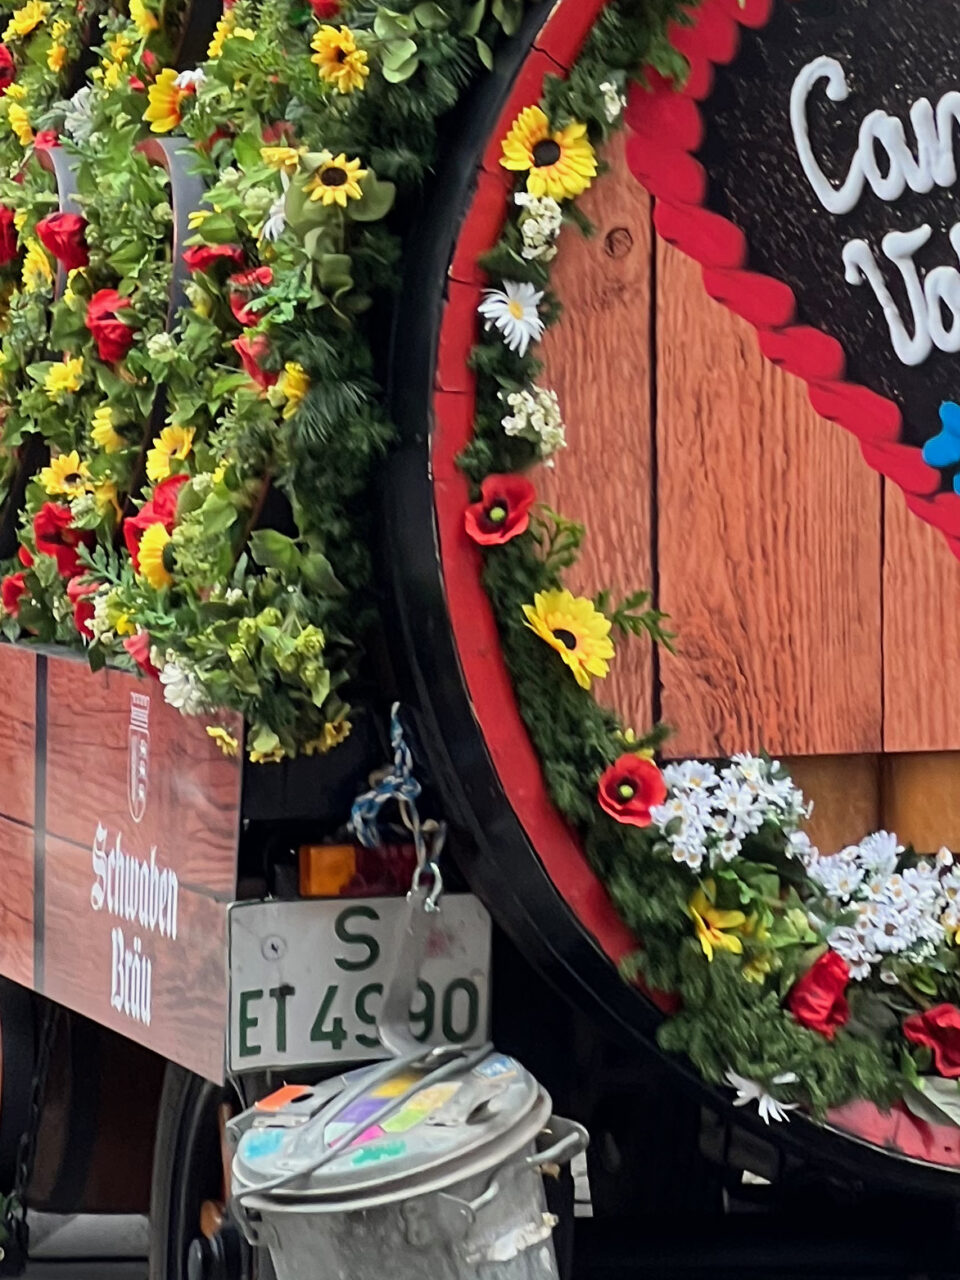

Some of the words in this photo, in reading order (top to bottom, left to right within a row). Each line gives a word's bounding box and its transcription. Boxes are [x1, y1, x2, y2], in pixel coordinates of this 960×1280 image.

[91, 820, 179, 941] Schwaben
[111, 926, 152, 1027] Bräu
[334, 905, 380, 972] S
[239, 982, 295, 1058] ET
